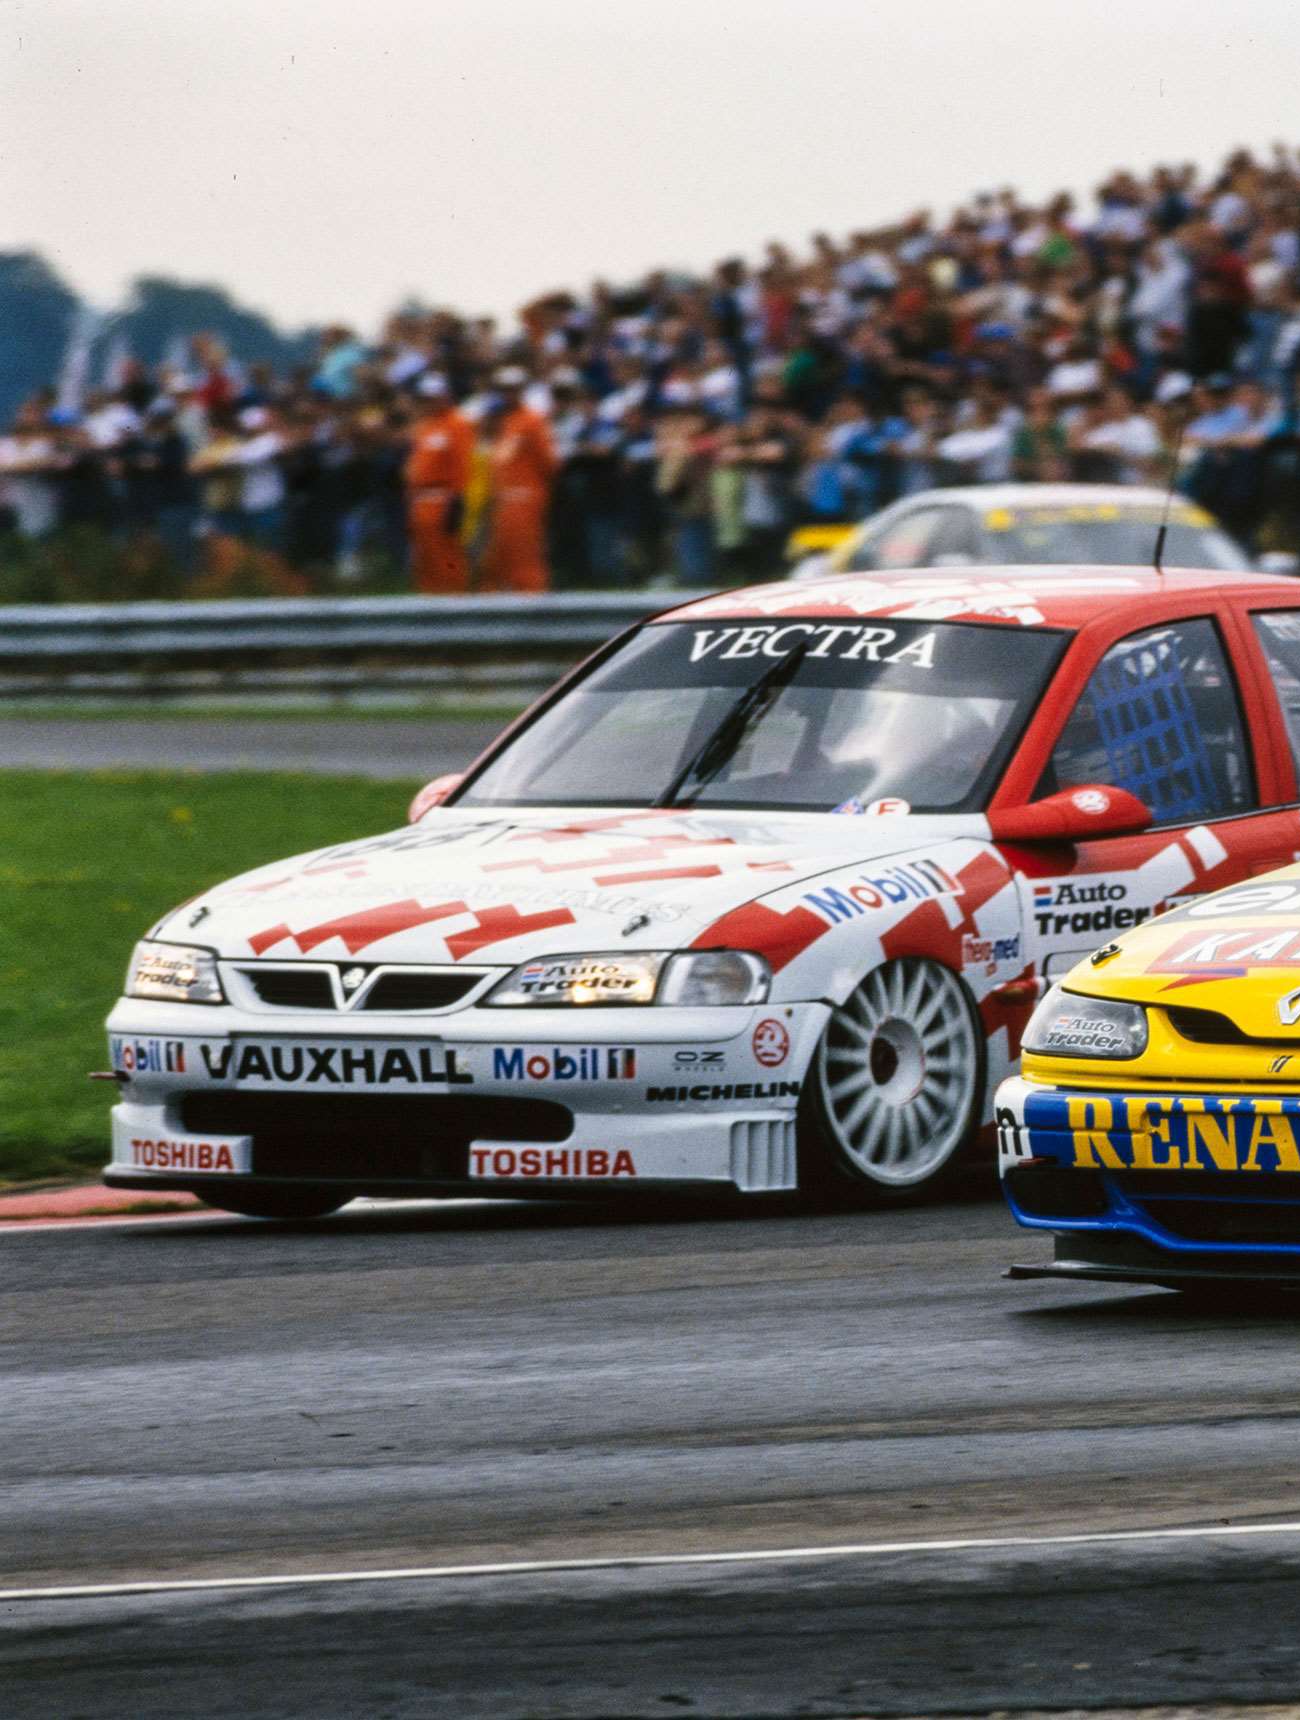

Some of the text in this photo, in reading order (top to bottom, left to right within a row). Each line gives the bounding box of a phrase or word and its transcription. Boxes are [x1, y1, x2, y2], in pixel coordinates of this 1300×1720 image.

[688, 624, 937, 668] VECTRA
[803, 862, 929, 924] Mobil
[1054, 883, 1127, 906] Auto
[1034, 906, 1151, 936] Trader
[136, 970, 198, 988] Trader
[544, 965, 619, 978] Auto
[521, 976, 641, 994] Trader
[1066, 1018, 1115, 1033] Auto
[1047, 1031, 1123, 1050] Trader
[112, 1038, 162, 1073] Mobil
[201, 1044, 472, 1084] VAUXHALL
[494, 1048, 598, 1080] Mobil
[675, 1051, 725, 1062] OZ
[647, 1081, 801, 1101] MICHELIN
[131, 1140, 233, 1170] TOSHIBA
[472, 1149, 636, 1178] TOSHIBA
